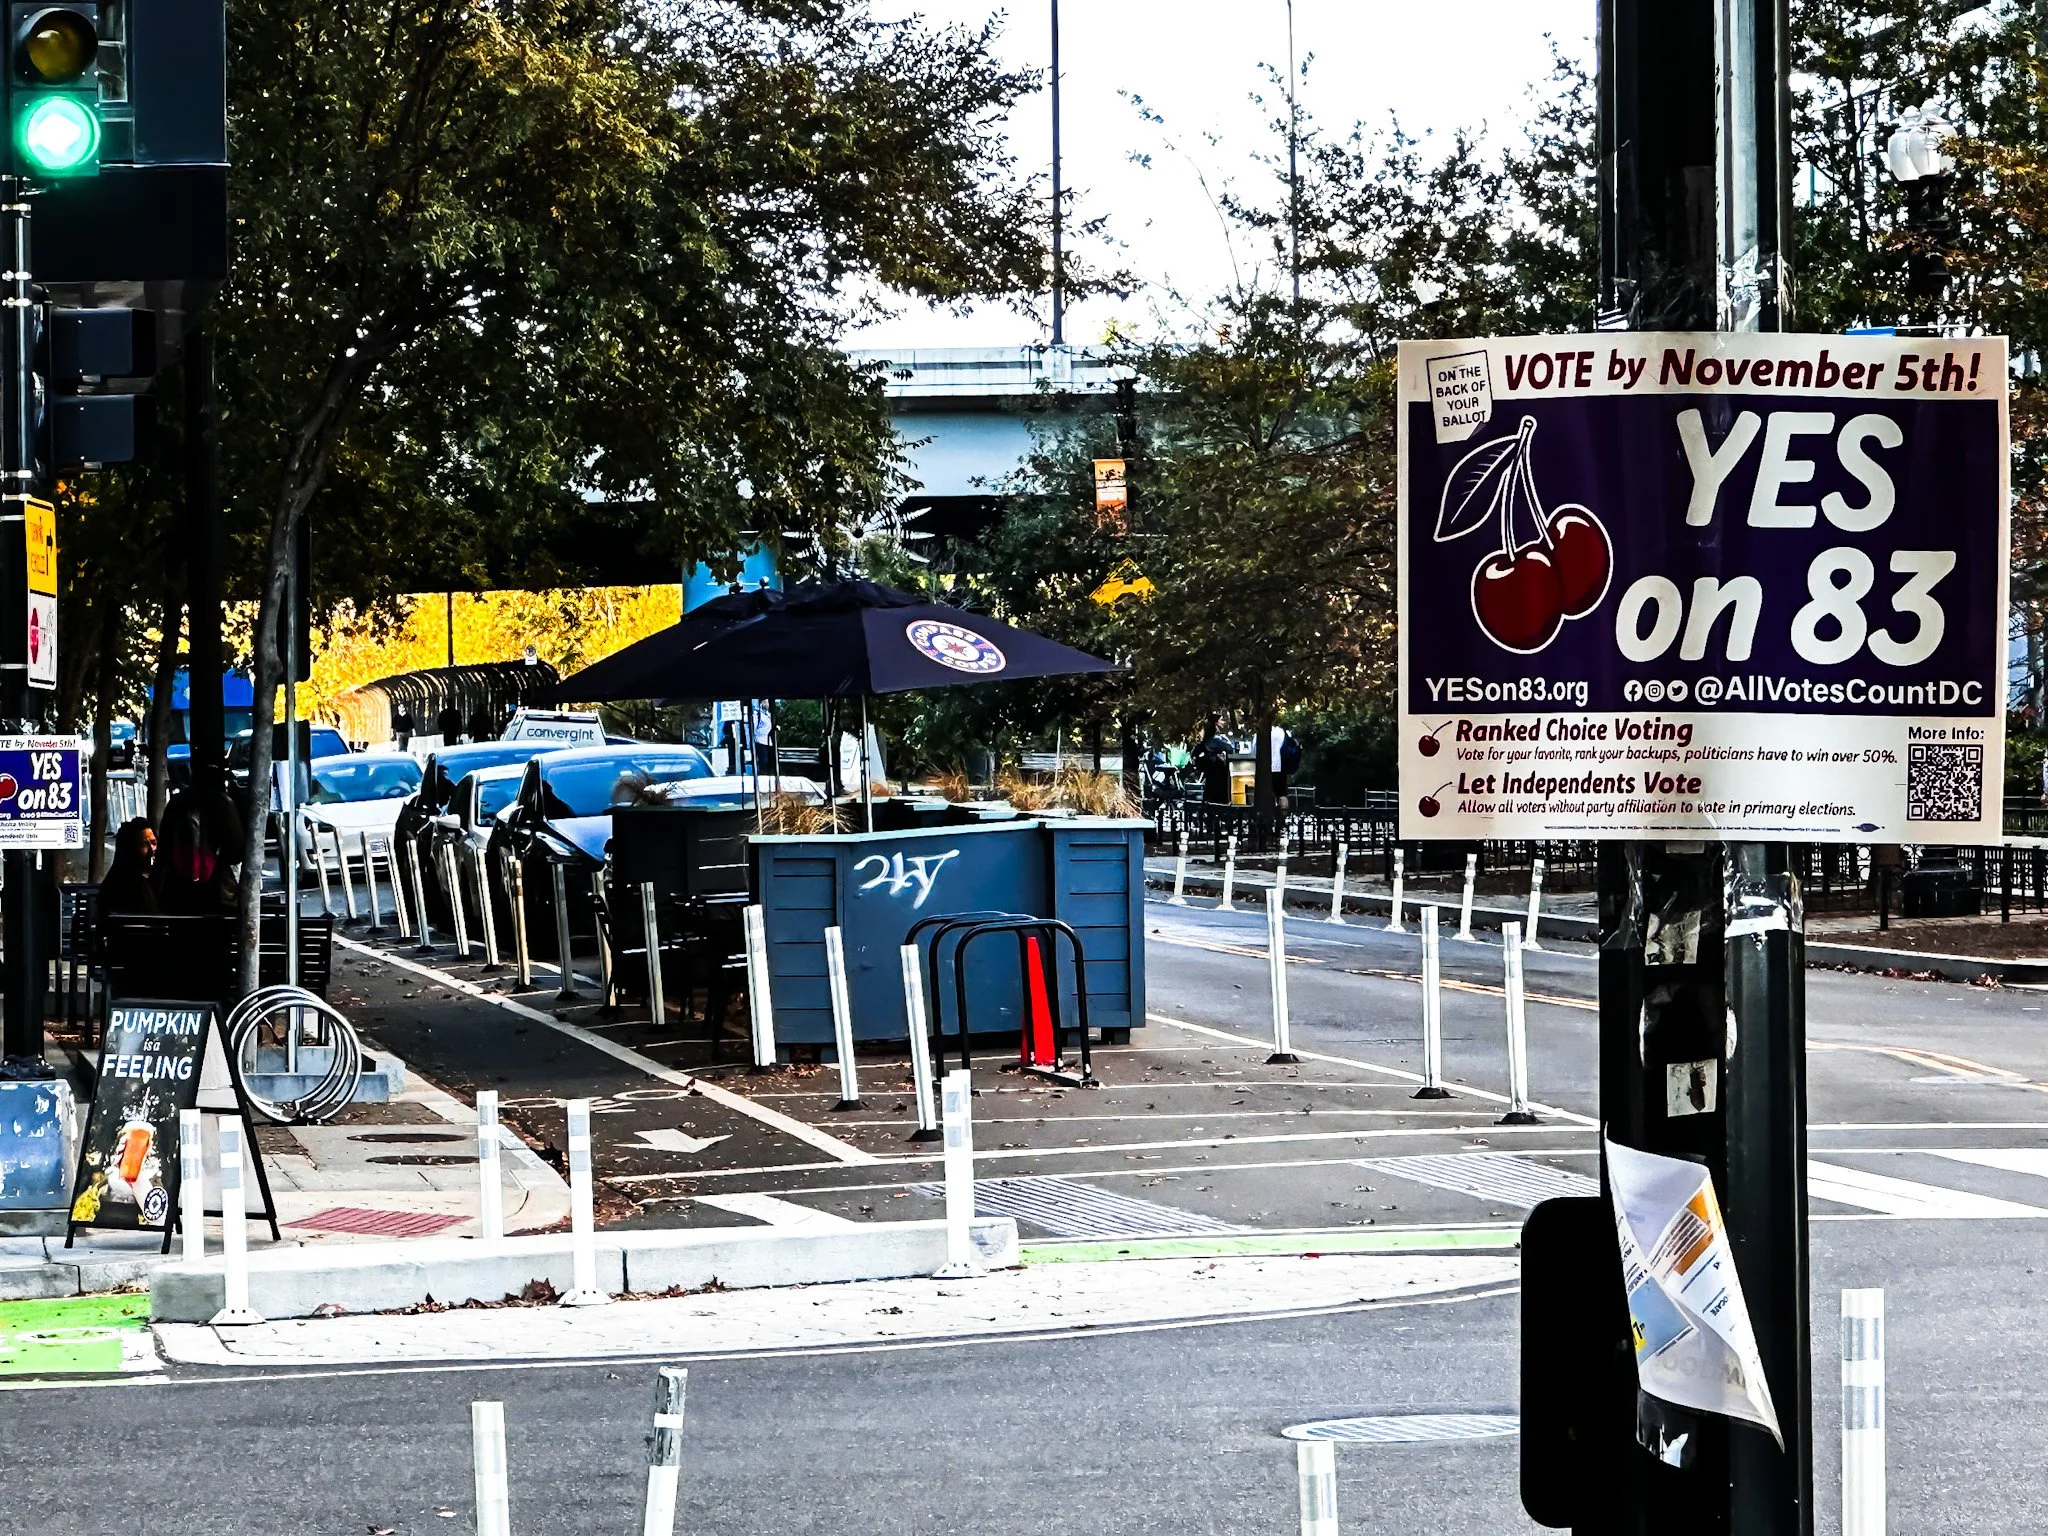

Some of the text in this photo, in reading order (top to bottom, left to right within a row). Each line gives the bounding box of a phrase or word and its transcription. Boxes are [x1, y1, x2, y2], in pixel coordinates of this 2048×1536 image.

[1437, 366, 1482, 383] ON THE
[1504, 348, 1982, 392] VOTE by November 5th!
[1435, 381, 1487, 398] BACK OF
[1446, 397, 1480, 411] YOUR
[1442, 411, 1487, 427] BALLOT
[1676, 408, 1904, 532] YES
[1615, 547, 1957, 666] on 83
[1425, 675, 1983, 707] YESon83.org @AllVotesCountDC
[526, 728, 594, 742] convergint
[1455, 716, 1694, 747] Ranked Choice Voting
[1907, 726, 1985, 740] More Info:
[30, 752, 62, 780] YES
[1456, 747, 1485, 761] Vote
[1487, 747, 1505, 761] for
[1506, 750, 1531, 764] your
[1575, 746, 1598, 760] rank
[1599, 749, 1623, 764] your
[1626, 746, 1681, 764] backups,
[1684, 744, 1754, 764] politicians
[1757, 746, 1788, 762] have
[1790, 748, 1803, 762] to
[1806, 747, 1829, 762] win
[1831, 751, 1861, 763] over
[1862, 749, 1898, 764] 50%.
[17, 781, 73, 810] on 83
[1457, 770, 1702, 801] Let Independents Vote
[1457, 799, 1496, 814] Allow
[1498, 799, 1514, 814] all
[1516, 801, 1547, 814] voters
[1549, 799, 1585, 814] without
[1586, 801, 1615, 817] party
[1616, 799, 1676, 814] affiliation
[1680, 801, 1693, 814] to
[1728, 800, 1741, 814] in
[1743, 801, 1796, 818] primary
[1798, 800, 1856, 816] elections.
[109, 1010, 201, 1035] PUMPKIN
[143, 1037, 161, 1052] is a
[101, 1053, 193, 1080] FEELING
